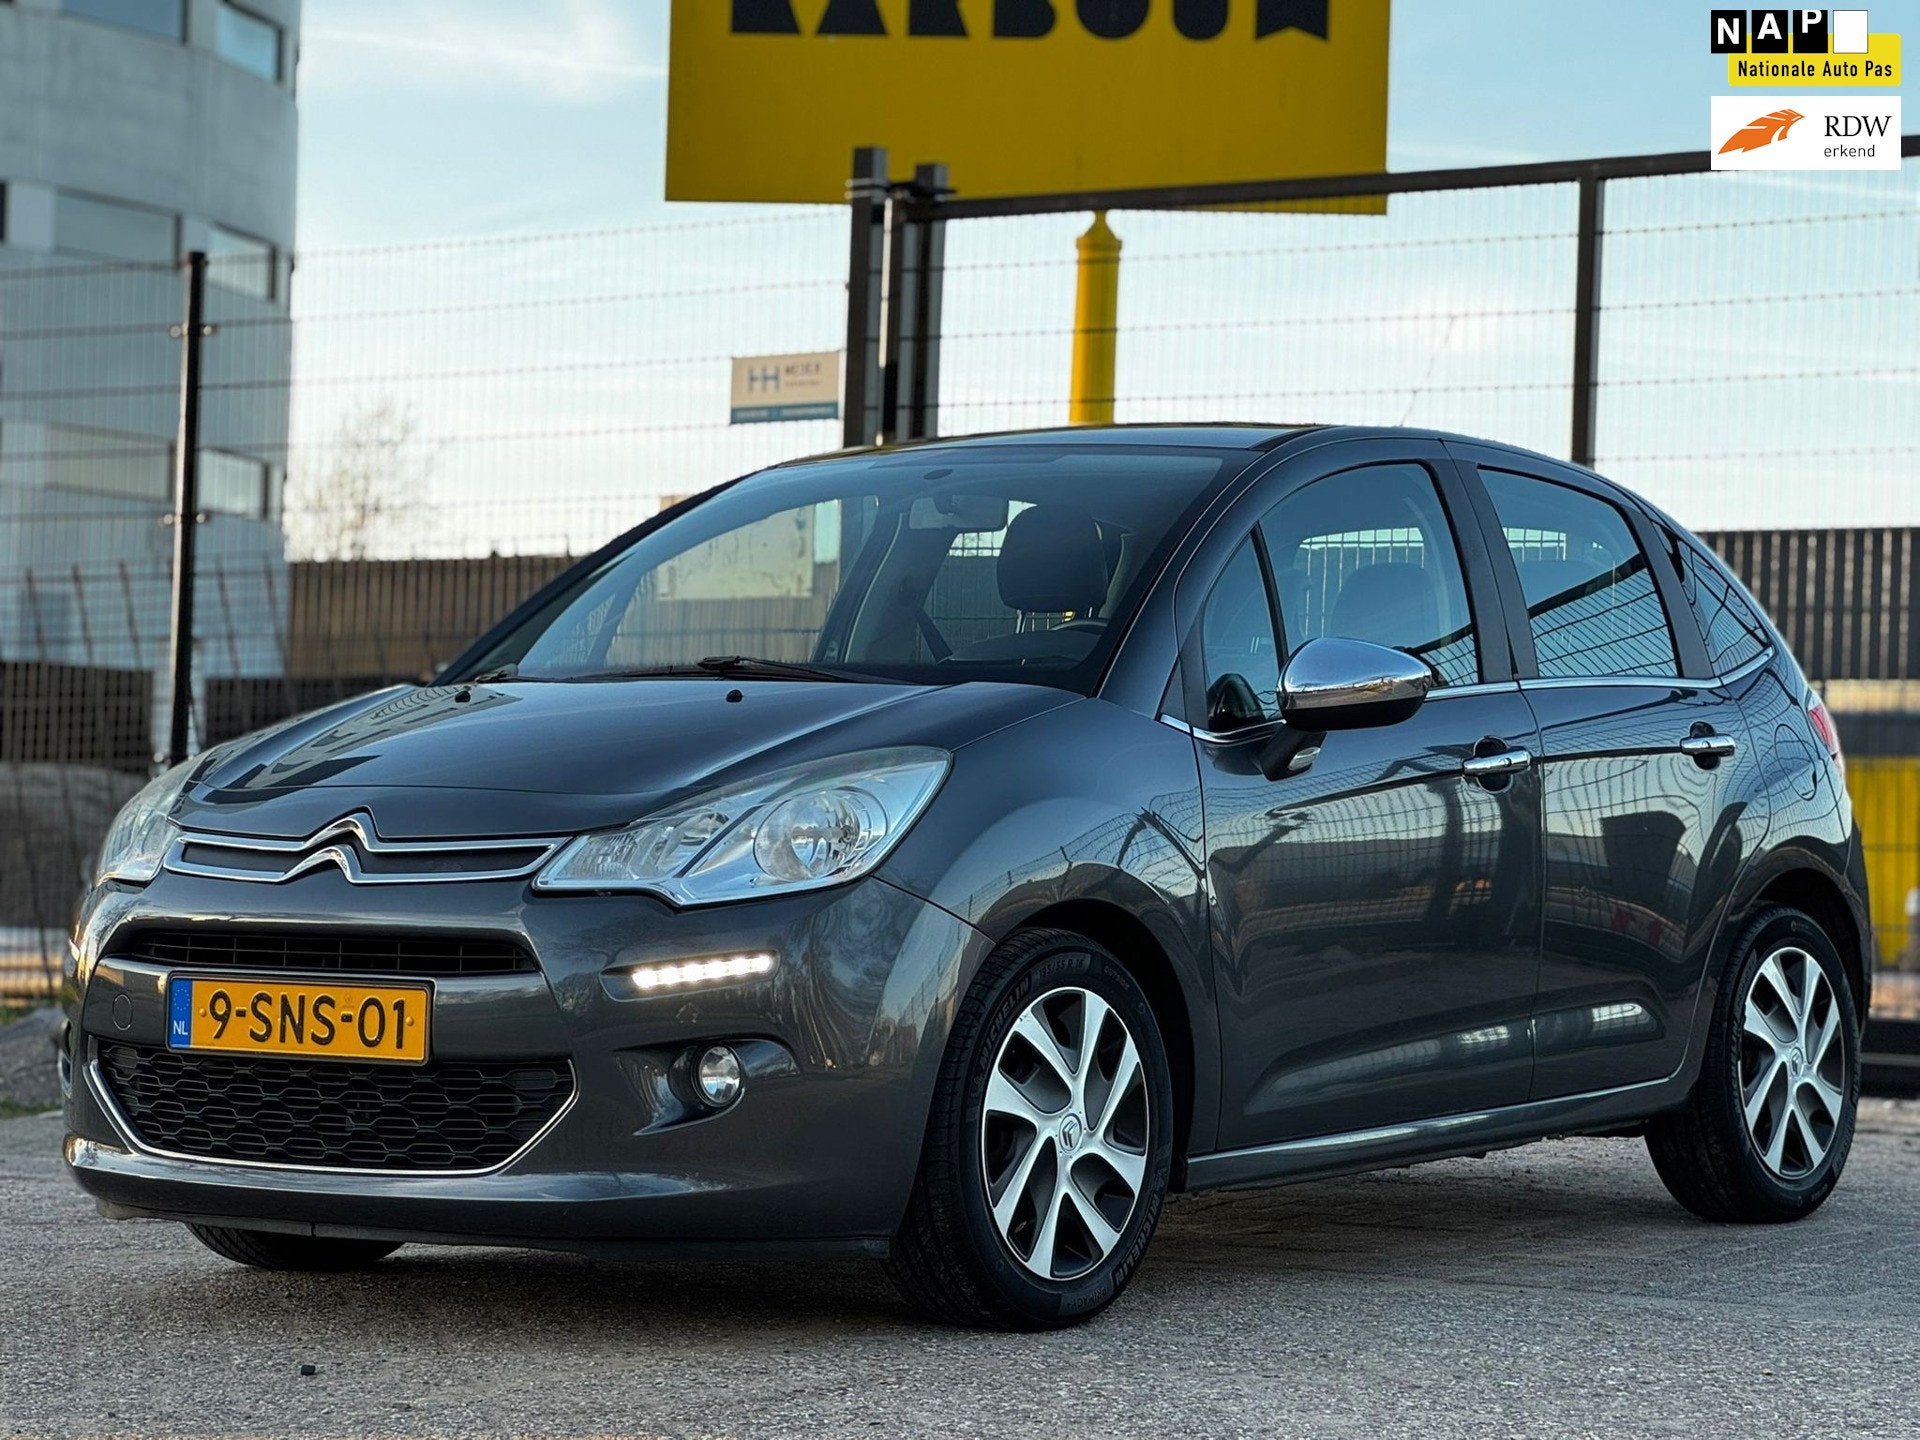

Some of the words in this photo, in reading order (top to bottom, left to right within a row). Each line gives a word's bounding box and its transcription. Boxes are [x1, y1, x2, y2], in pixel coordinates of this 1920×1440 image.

[173, 1020, 188, 1036] NL
[208, 988, 405, 1049] 9-SNS-01
[979, 976, 1030, 1070] MICHELIN
